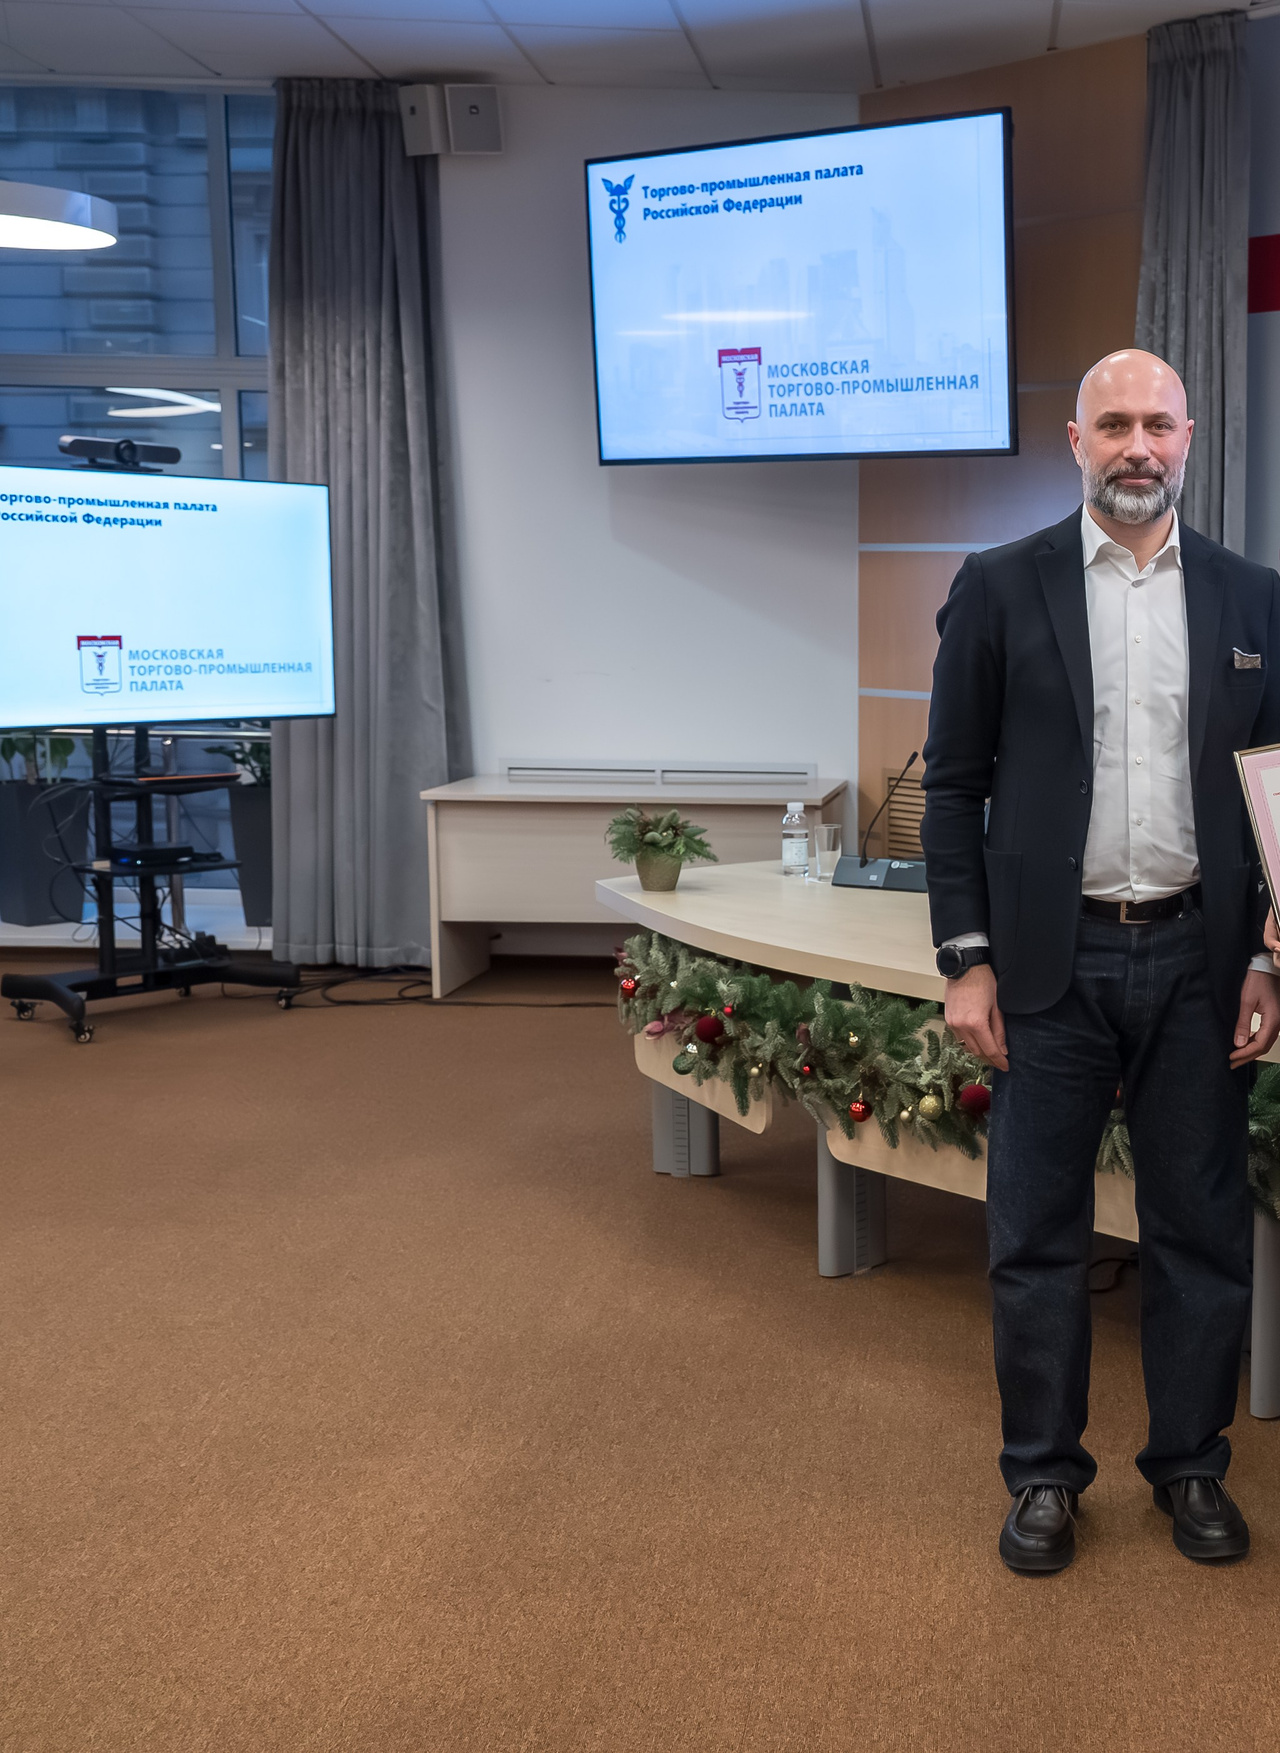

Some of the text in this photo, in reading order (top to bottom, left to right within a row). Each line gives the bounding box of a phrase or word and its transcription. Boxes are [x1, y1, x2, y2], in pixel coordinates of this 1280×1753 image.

[642, 164, 864, 202] Торгово-промышленная палата
[643, 193, 803, 221] Российской Федерации
[767, 359, 870, 379] МОСКОВСКАЯ
[767, 374, 979, 398] ТОРГОВО-ПРОМЫШЛЕННАЯ
[769, 402, 825, 418] ПАЛАТА
[173, 502, 218, 512] палата
[0, 510, 162, 528] оссийской Федерации
[128, 648, 224, 661] МОСКОВСКАЯ
[128, 662, 313, 677] ТОРГОВО-ПРОМЫШЛЕННАЯ
[129, 680, 184, 692] ПАЛАТА
